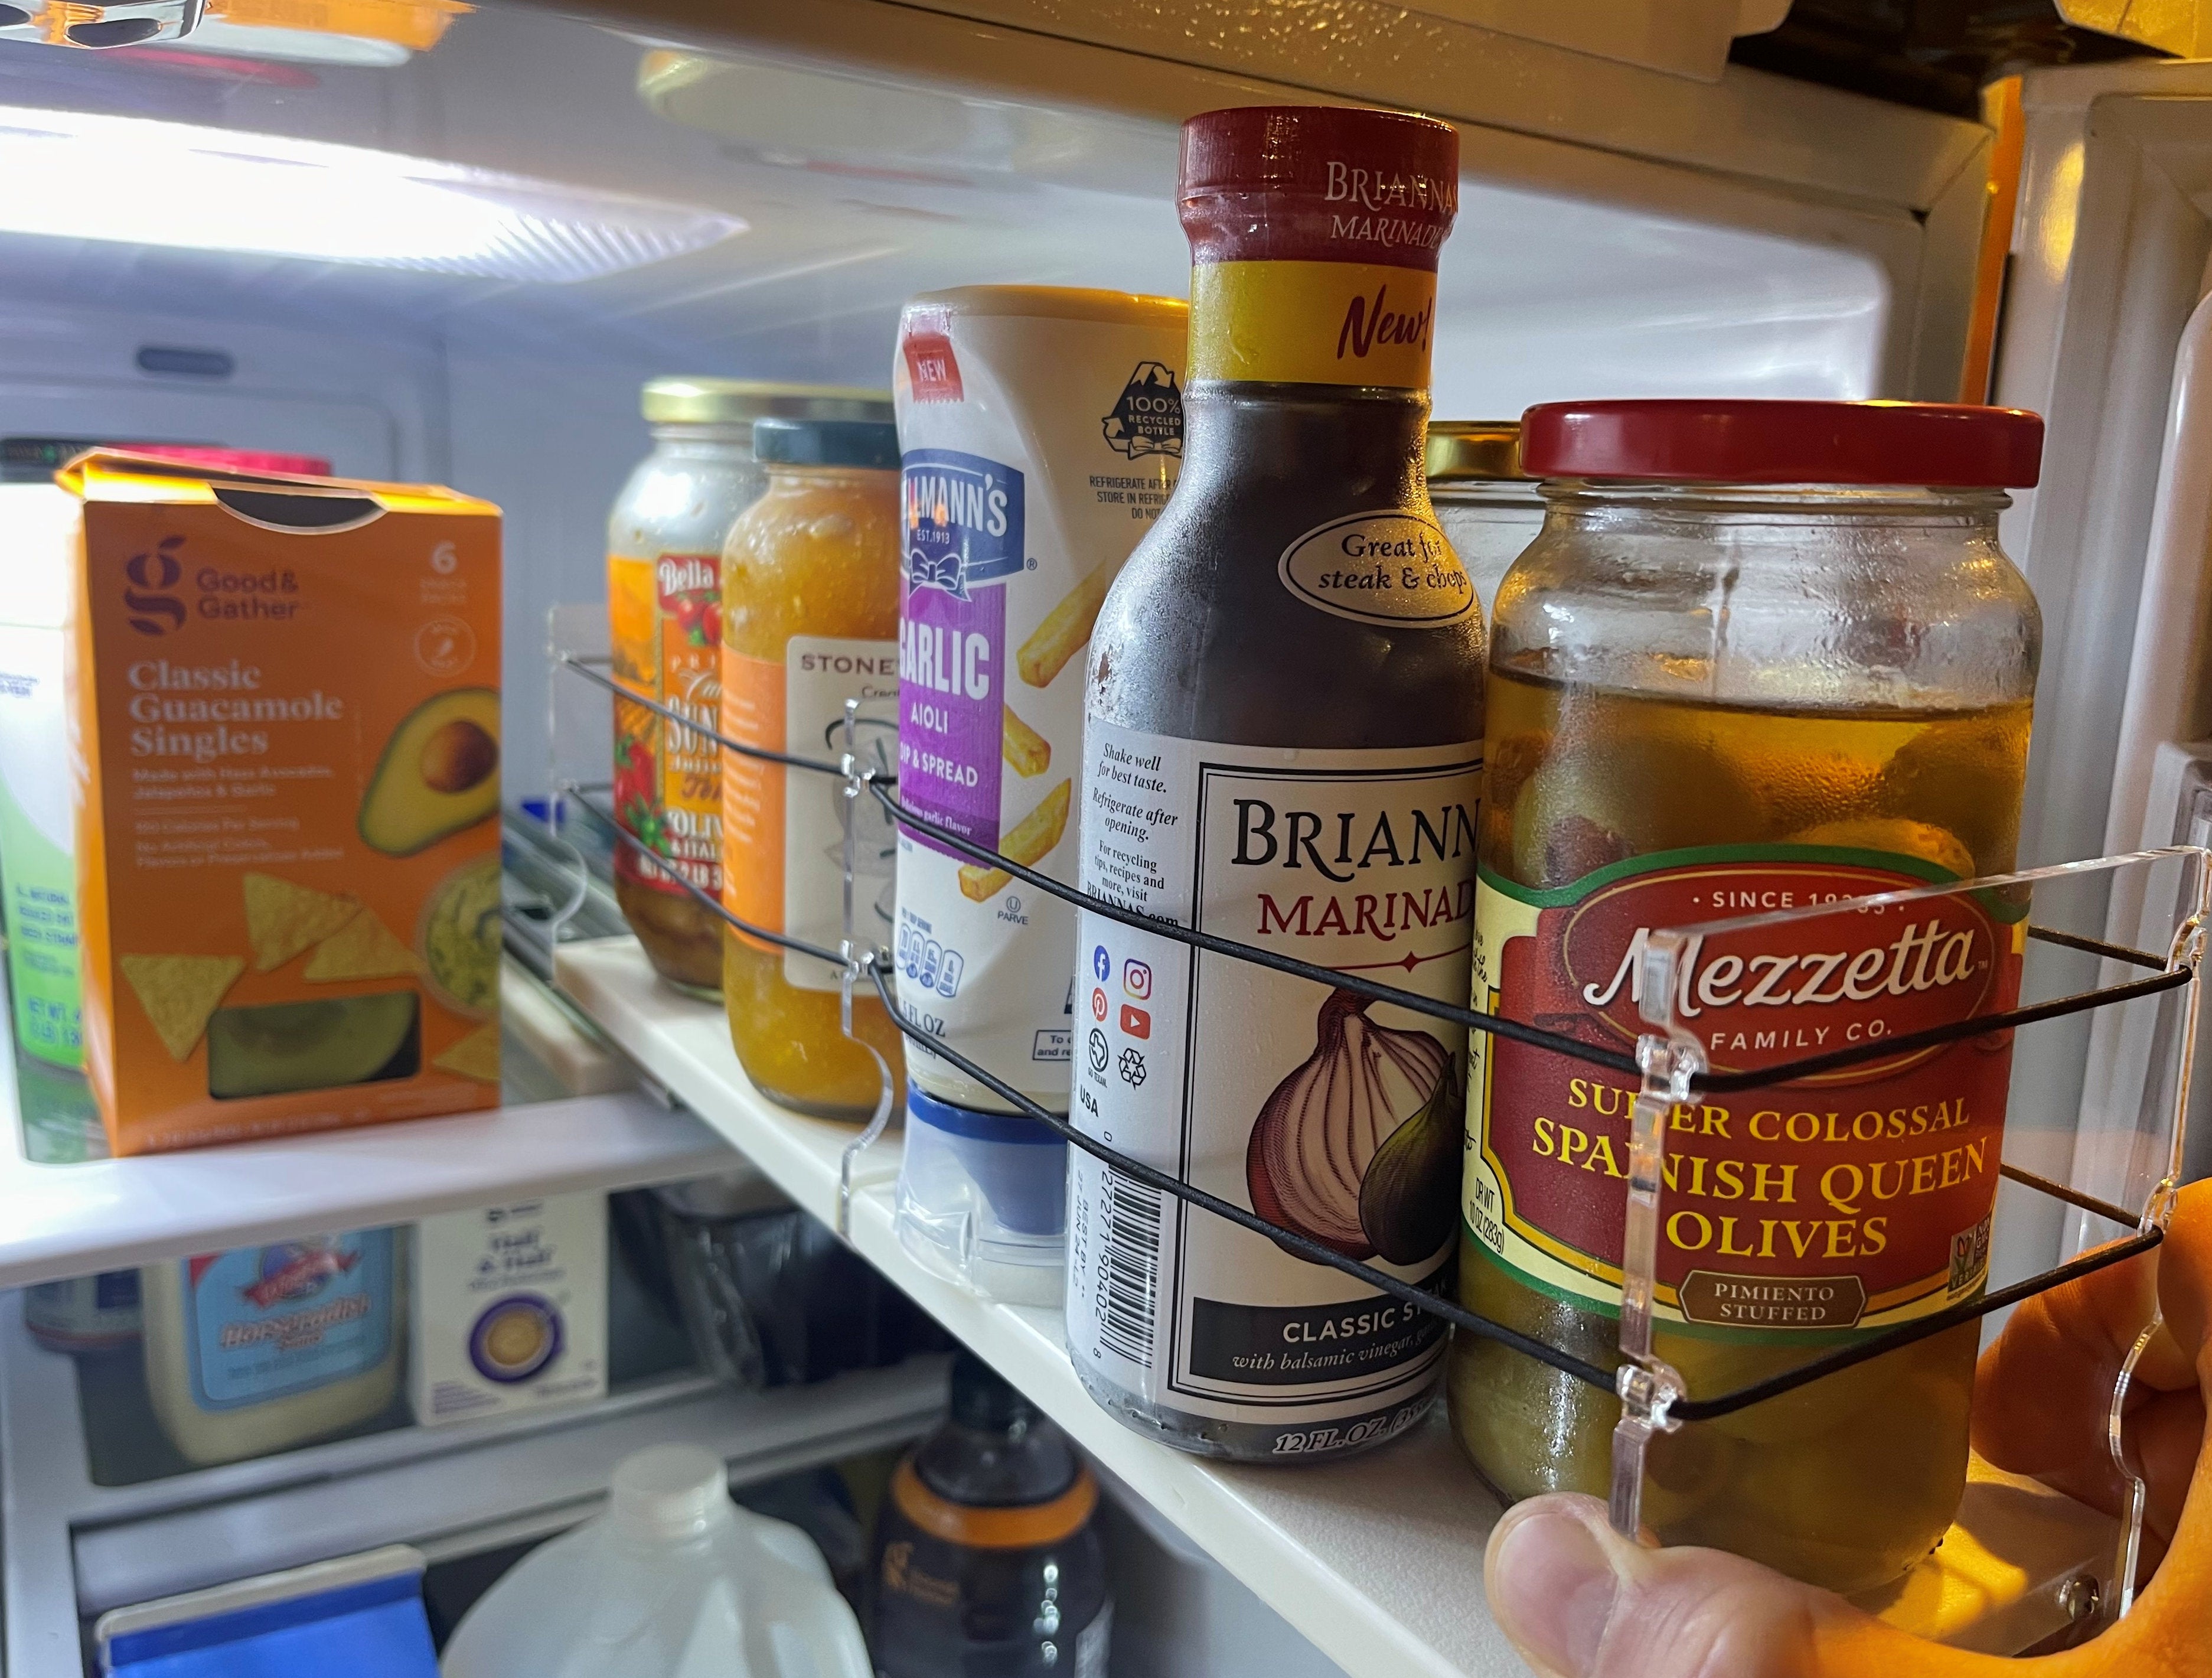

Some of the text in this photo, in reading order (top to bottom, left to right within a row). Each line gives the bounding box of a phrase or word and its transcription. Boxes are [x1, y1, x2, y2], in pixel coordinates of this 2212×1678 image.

[1337, 284, 1432, 360] New!
[917, 359, 946, 382] NEW
[1127, 396, 1180, 413] 100%
[1128, 415, 1181, 426] RECYCLED
[1137, 425, 1174, 436] BOTTLE
[1089, 475, 1146, 490] REFRIGERATE
[1097, 491, 1124, 503] STORE
[1127, 493, 1136, 504] IN
[1132, 508, 1143, 519] DO
[432, 540, 458, 574] 6
[1341, 533, 1415, 557] Great
[658, 559, 714, 596] Bella
[1318, 562, 1467, 594] steak & chops
[197, 597, 299, 620] Gather
[801, 654, 899, 676] STONE
[899, 617, 990, 700] GARLIC
[128, 660, 262, 691] Classic
[129, 691, 343, 723] Guacamole
[911, 702, 948, 735] AIOLI
[130, 727, 269, 763] Singles
[1104, 742, 1162, 771] Shake well
[900, 742, 978, 787] DIP & SPREAD
[1097, 760, 1167, 793] for best taste.
[1093, 787, 1178, 827] Refrigerate after
[945, 816, 973, 835] flavor
[1105, 817, 1149, 843] opening.
[1231, 798, 1480, 882] BRIANN
[1094, 855, 1164, 889] tips, recipes and
[1100, 839, 1157, 874] For recycling
[1087, 881, 1179, 926] BRIANNAScom
[1102, 875, 1148, 902] more, visit
[1713, 891, 1793, 908] SINCE
[997, 911, 1029, 926] PARVE
[1583, 918, 1978, 1017] Mezzetta
[924, 1014, 945, 1037] OZ
[1050, 1035, 1063, 1044] To
[1710, 1019, 1892, 1051] FAMILY CO.
[1038, 1047, 1059, 1056] and
[1080, 1083, 1099, 1118] USA
[1749, 1097, 1970, 1144] COLOSSAL
[1821, 1136, 1988, 1214] QUEEN
[1100, 1170, 1113, 1242] 27271
[1484, 1184, 1495, 1213] WT
[1483, 1214, 1505, 1256] (283g)
[1666, 1210, 1888, 1259] OLIVES
[1095, 1253, 1110, 1322] 90402
[1714, 1282, 1834, 1302] PIMIENTO
[1283, 1307, 1396, 1343] CLASSIC
[1721, 1302, 1826, 1321] STUFFED
[1232, 1354, 1275, 1370] with
[1280, 1349, 1355, 1370] balsamic
[1358, 1335, 1414, 1361] vinegar,
[1274, 1435, 1304, 1452] 12
